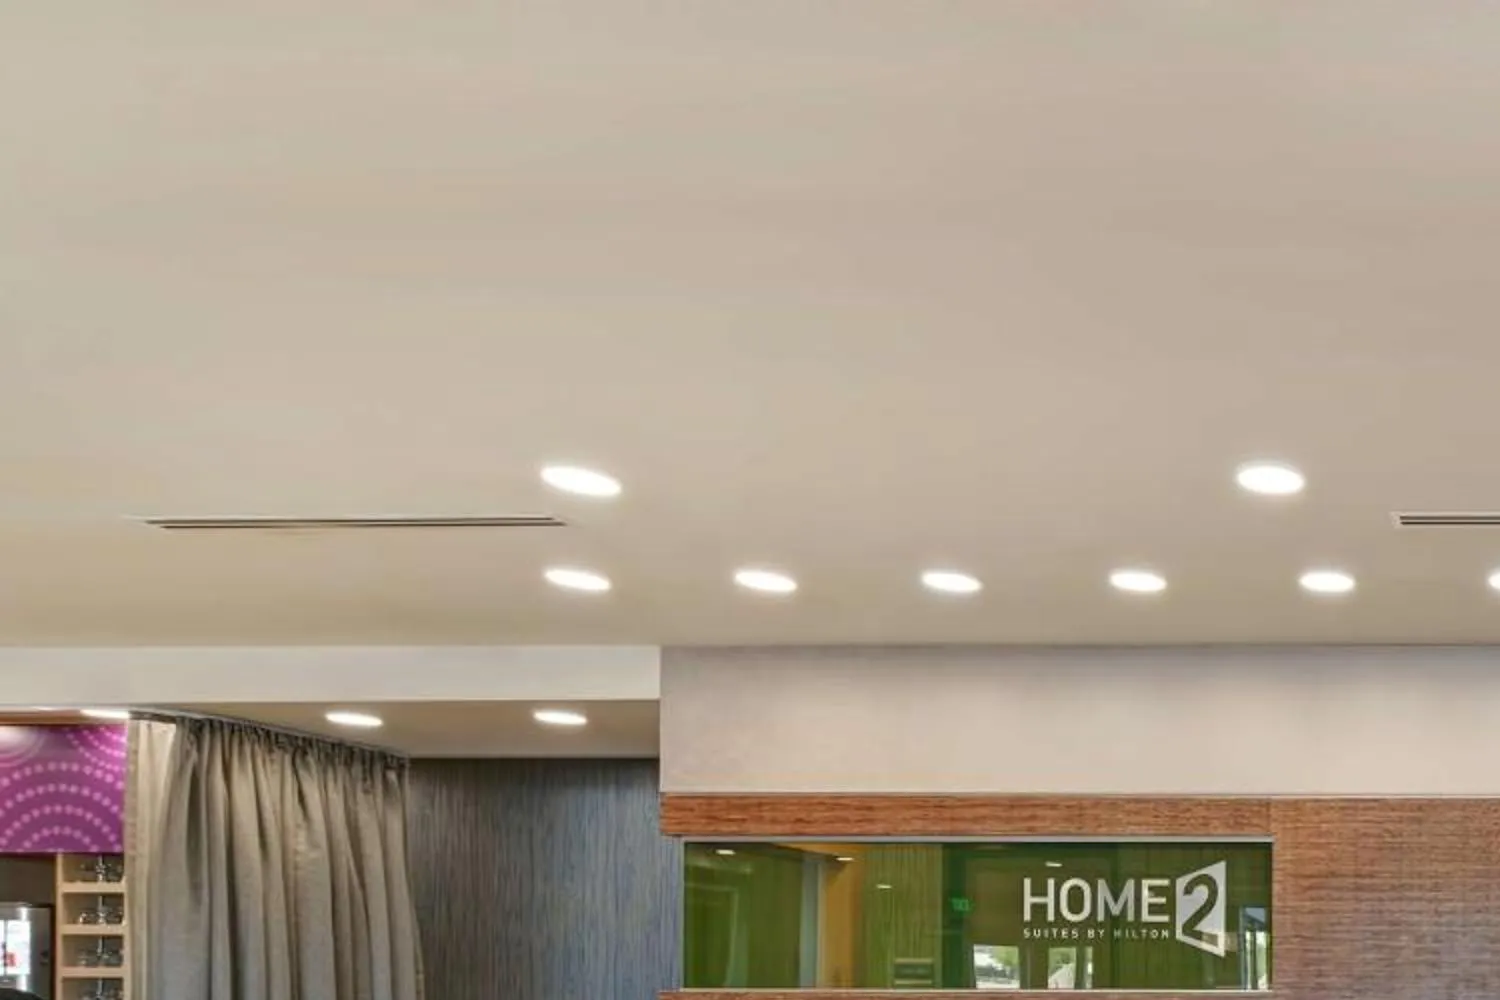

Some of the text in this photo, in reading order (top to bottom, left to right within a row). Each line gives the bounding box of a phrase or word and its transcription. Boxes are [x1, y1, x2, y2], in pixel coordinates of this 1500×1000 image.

[1023, 929, 1170, 939] SUITES BY HILTON
